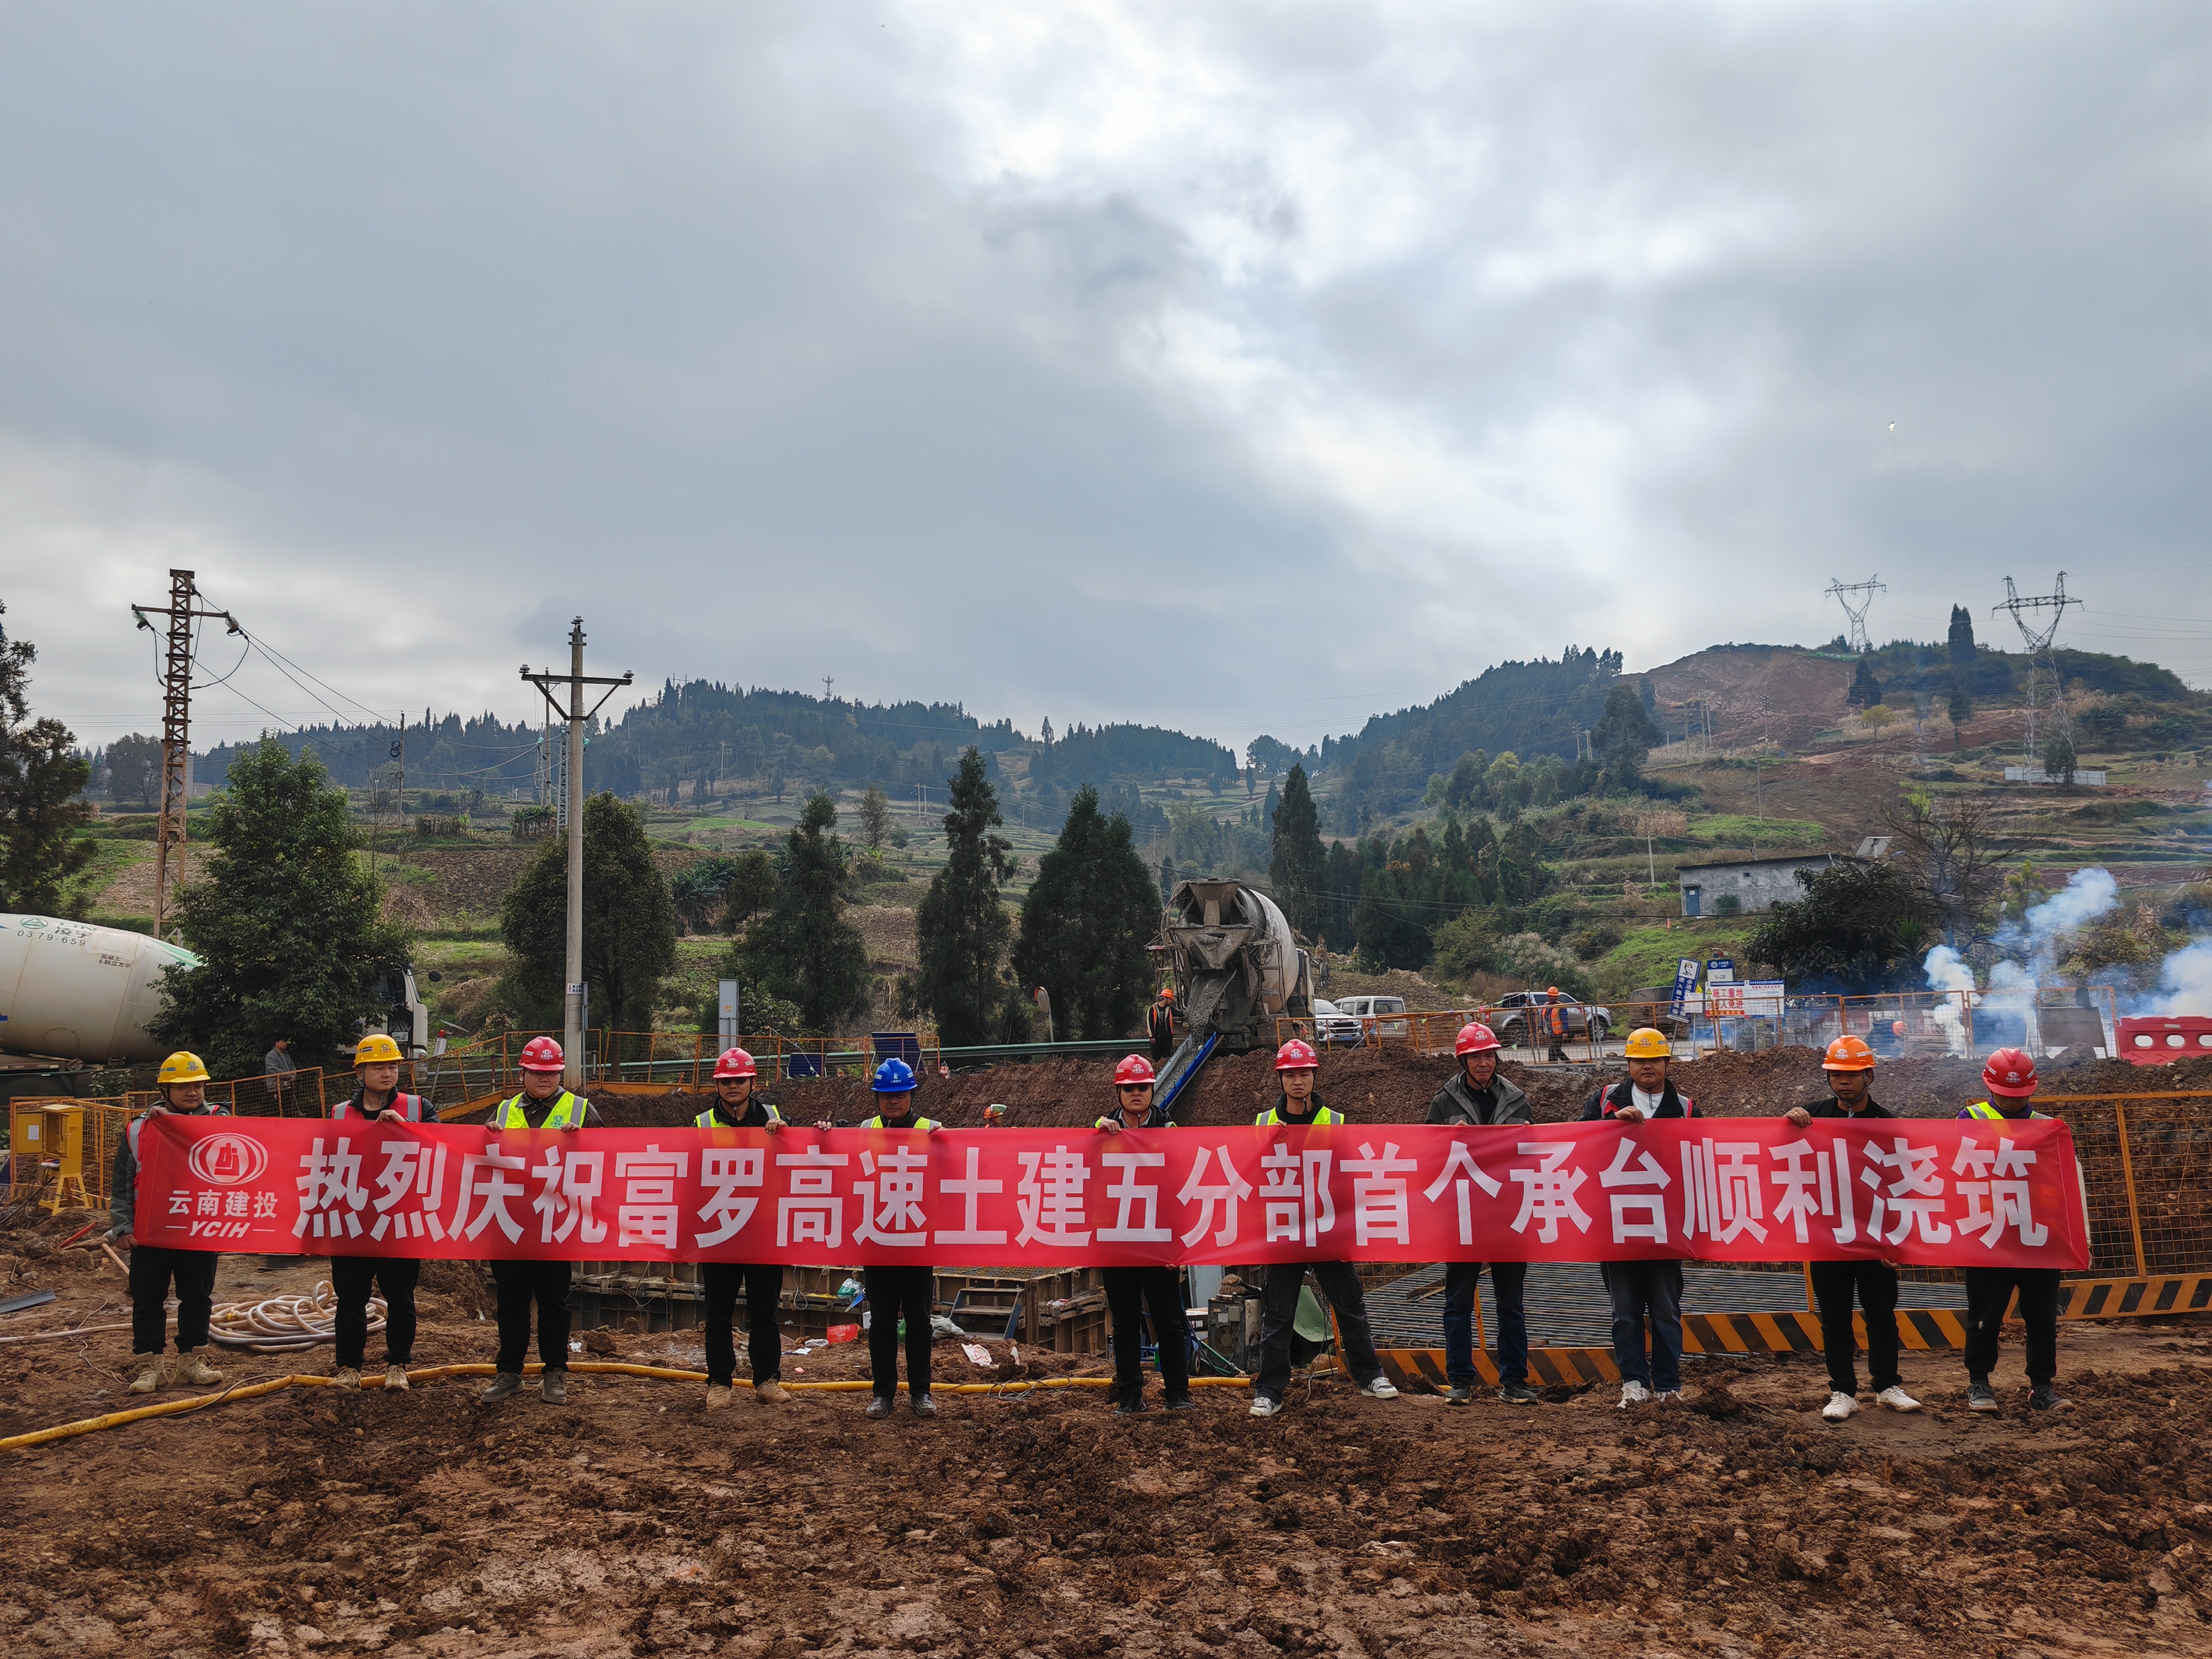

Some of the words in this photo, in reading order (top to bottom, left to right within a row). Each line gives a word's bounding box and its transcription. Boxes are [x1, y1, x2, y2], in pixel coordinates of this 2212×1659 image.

[17, 930, 85, 946] 0379-659
[99, 958, 132, 969] 6.86立方米
[1712, 987, 1744, 998] 施工重地
[291, 1135, 2049, 1249] 热烈庆祝富罗高速土建五分部首个承台顺利浇筑
[168, 1189, 279, 1218] 云南建投
[189, 1220, 251, 1238] YCIH
